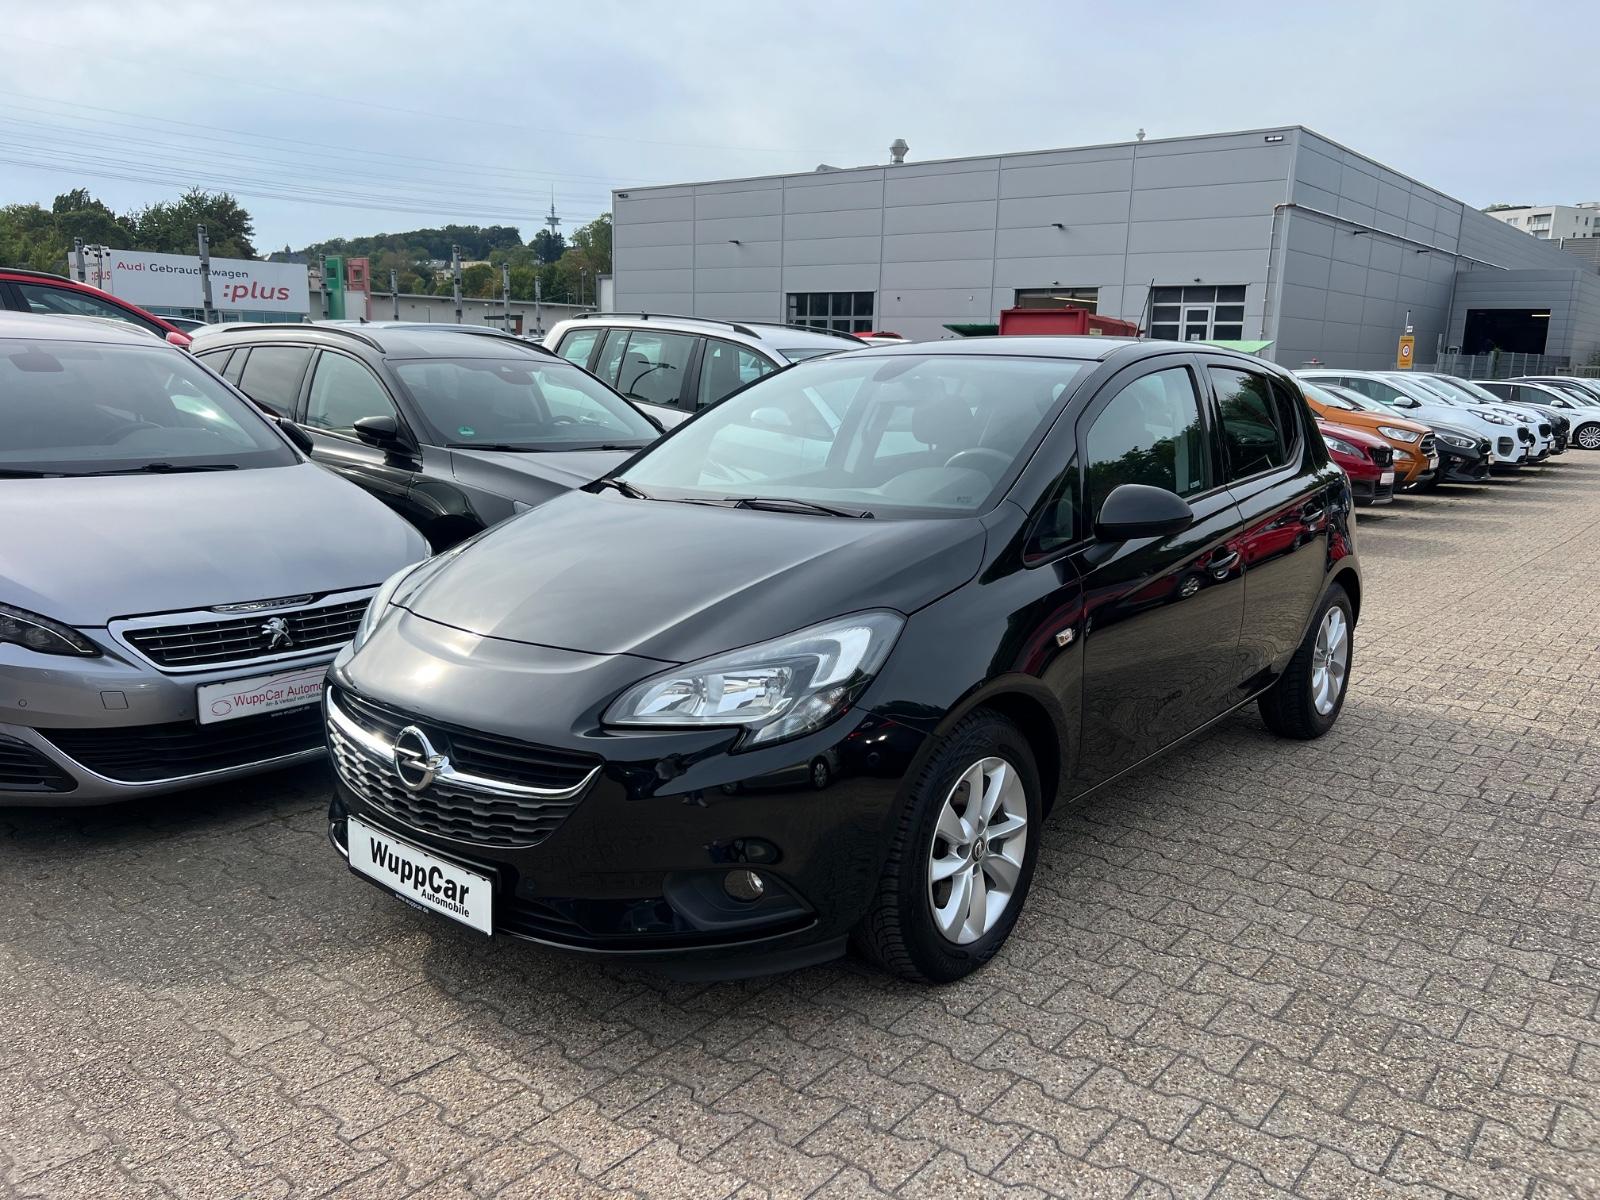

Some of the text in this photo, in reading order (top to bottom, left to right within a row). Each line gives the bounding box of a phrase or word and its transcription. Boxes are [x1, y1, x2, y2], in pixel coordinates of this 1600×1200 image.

[91, 271, 111, 284] :pus
[117, 261, 249, 280] Audi Gebraucwagen
[223, 281, 290, 303] :plus
[234, 691, 285, 707] WuppCar
[370, 837, 470, 905] WuppCar
[421, 889, 470, 918] Automobile
